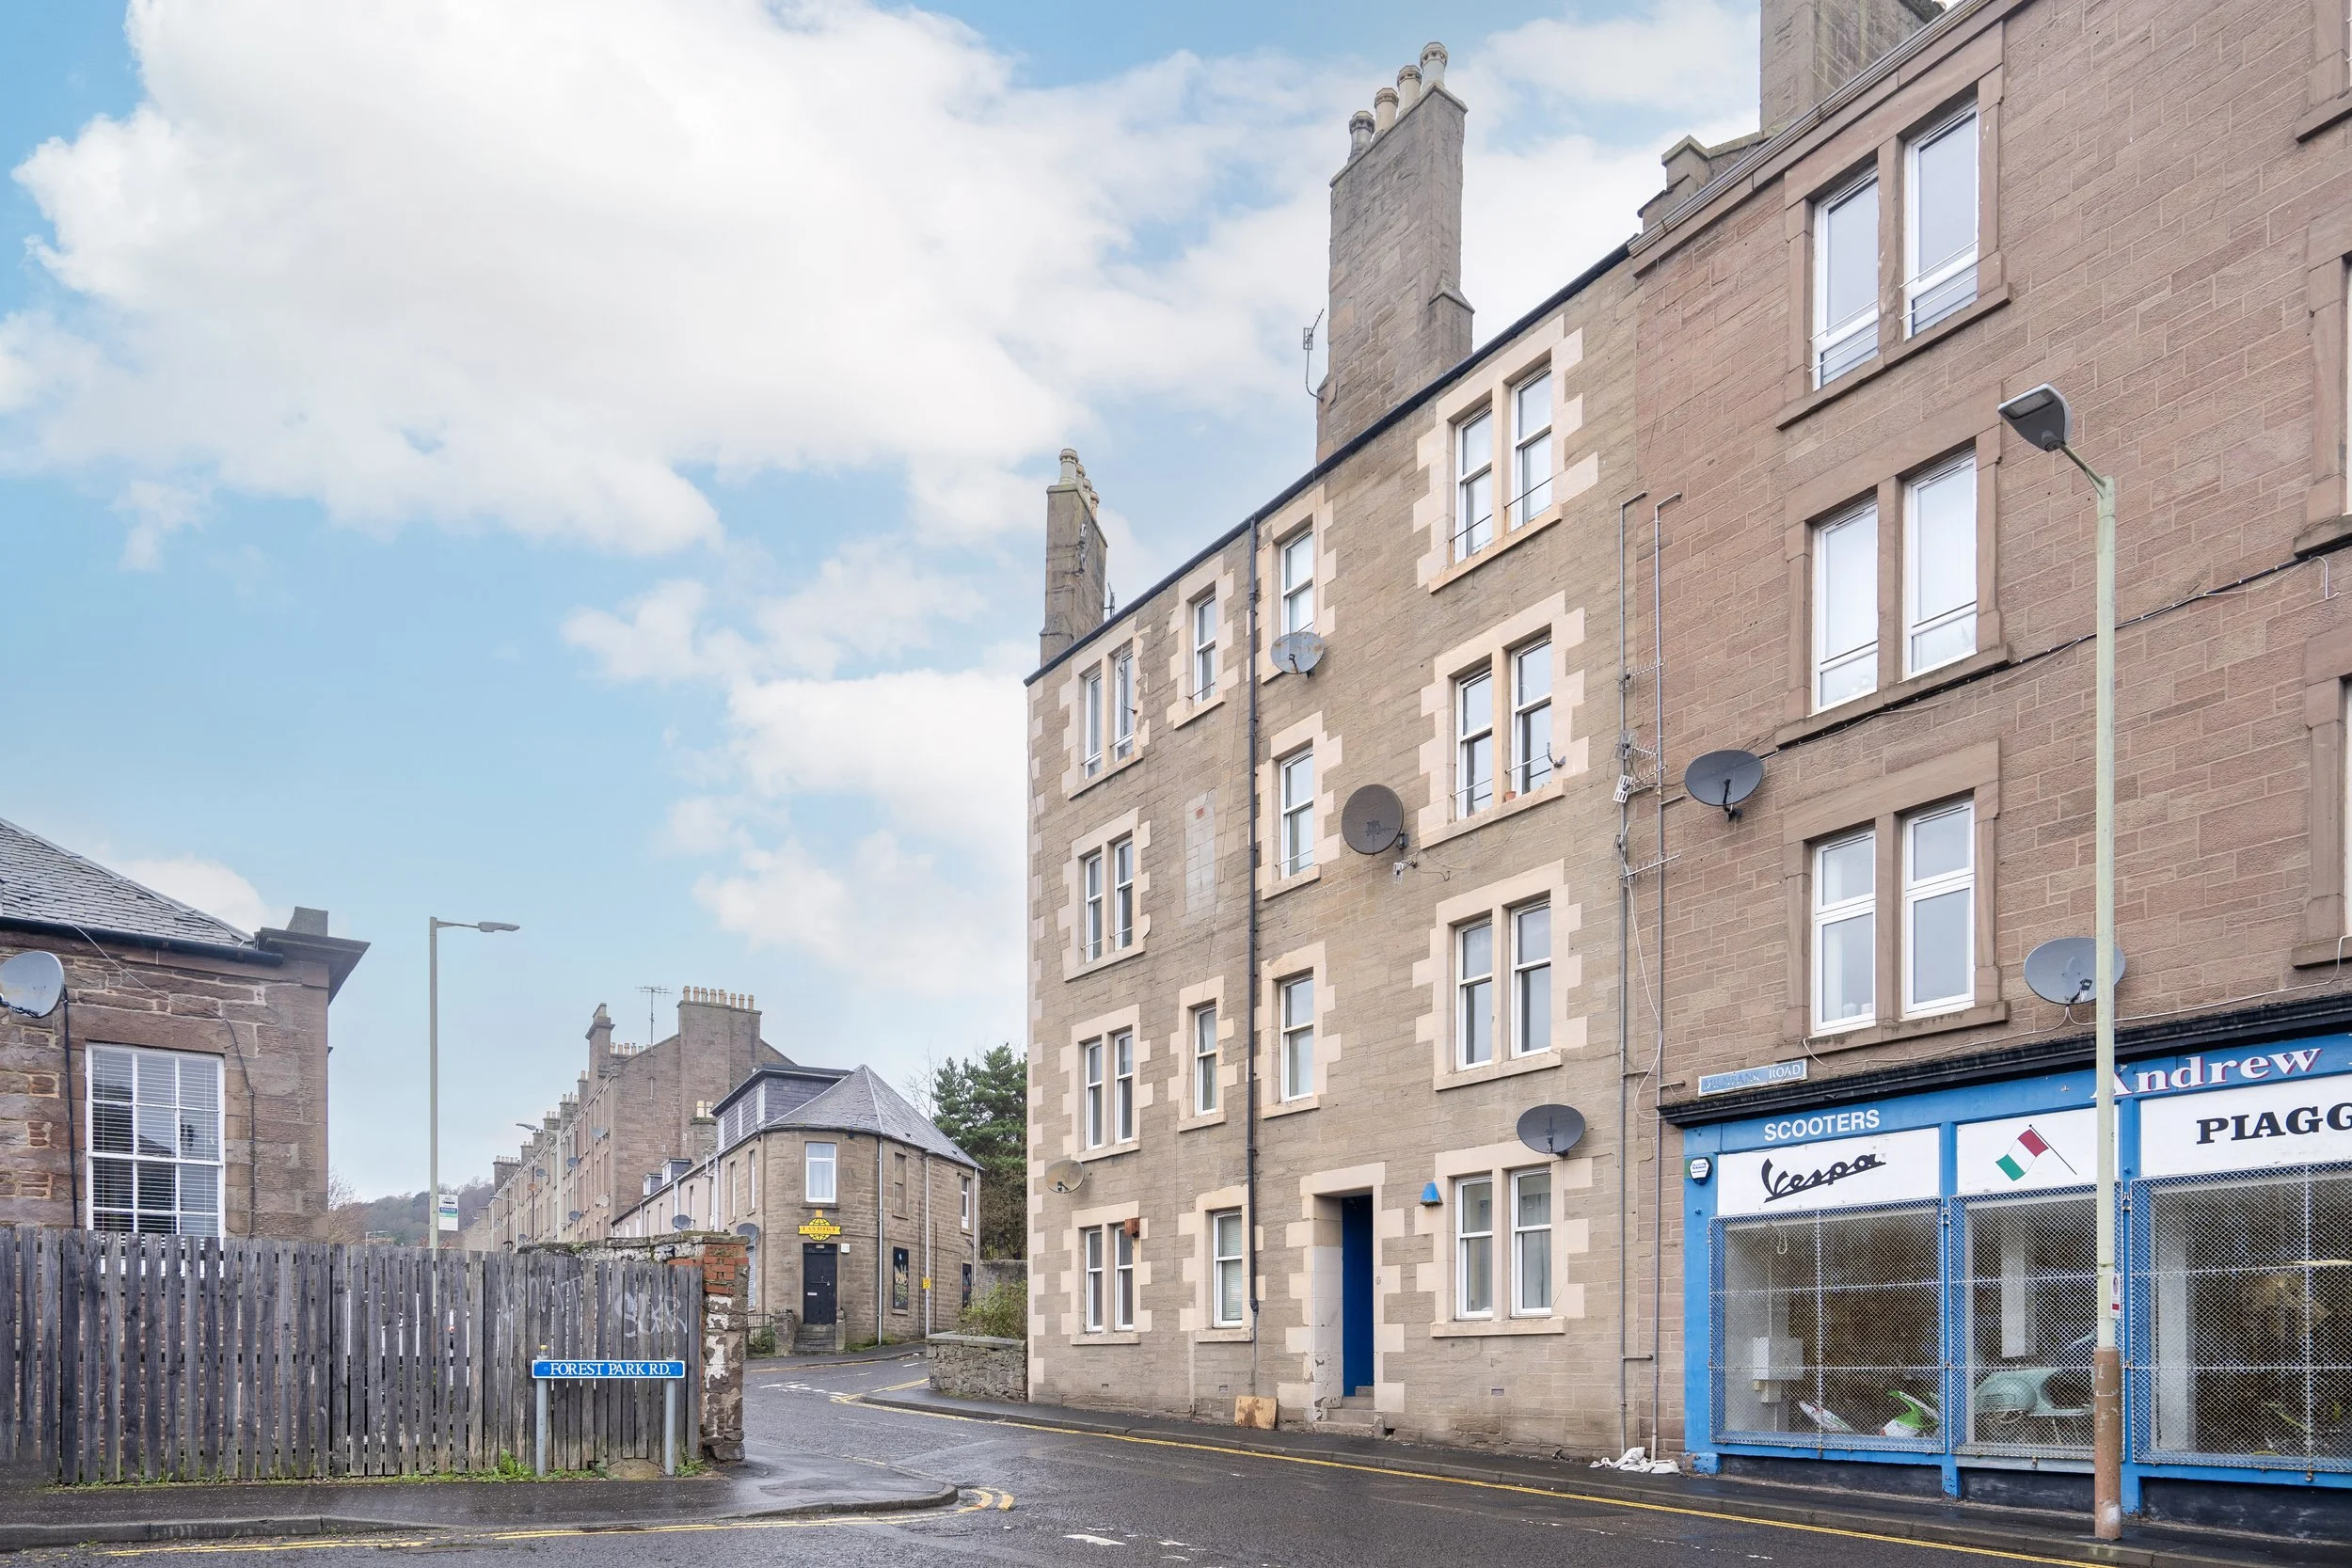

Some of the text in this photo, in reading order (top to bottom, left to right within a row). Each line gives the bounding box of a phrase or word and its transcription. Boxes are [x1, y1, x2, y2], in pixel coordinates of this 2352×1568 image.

[1769, 1064, 1801, 1079] ROAD
[1764, 1109, 1881, 1141] SCOOTERS
[1761, 1153, 1887, 1203] Vespa
[550, 1363, 671, 1376] FOREST PARK RD.
